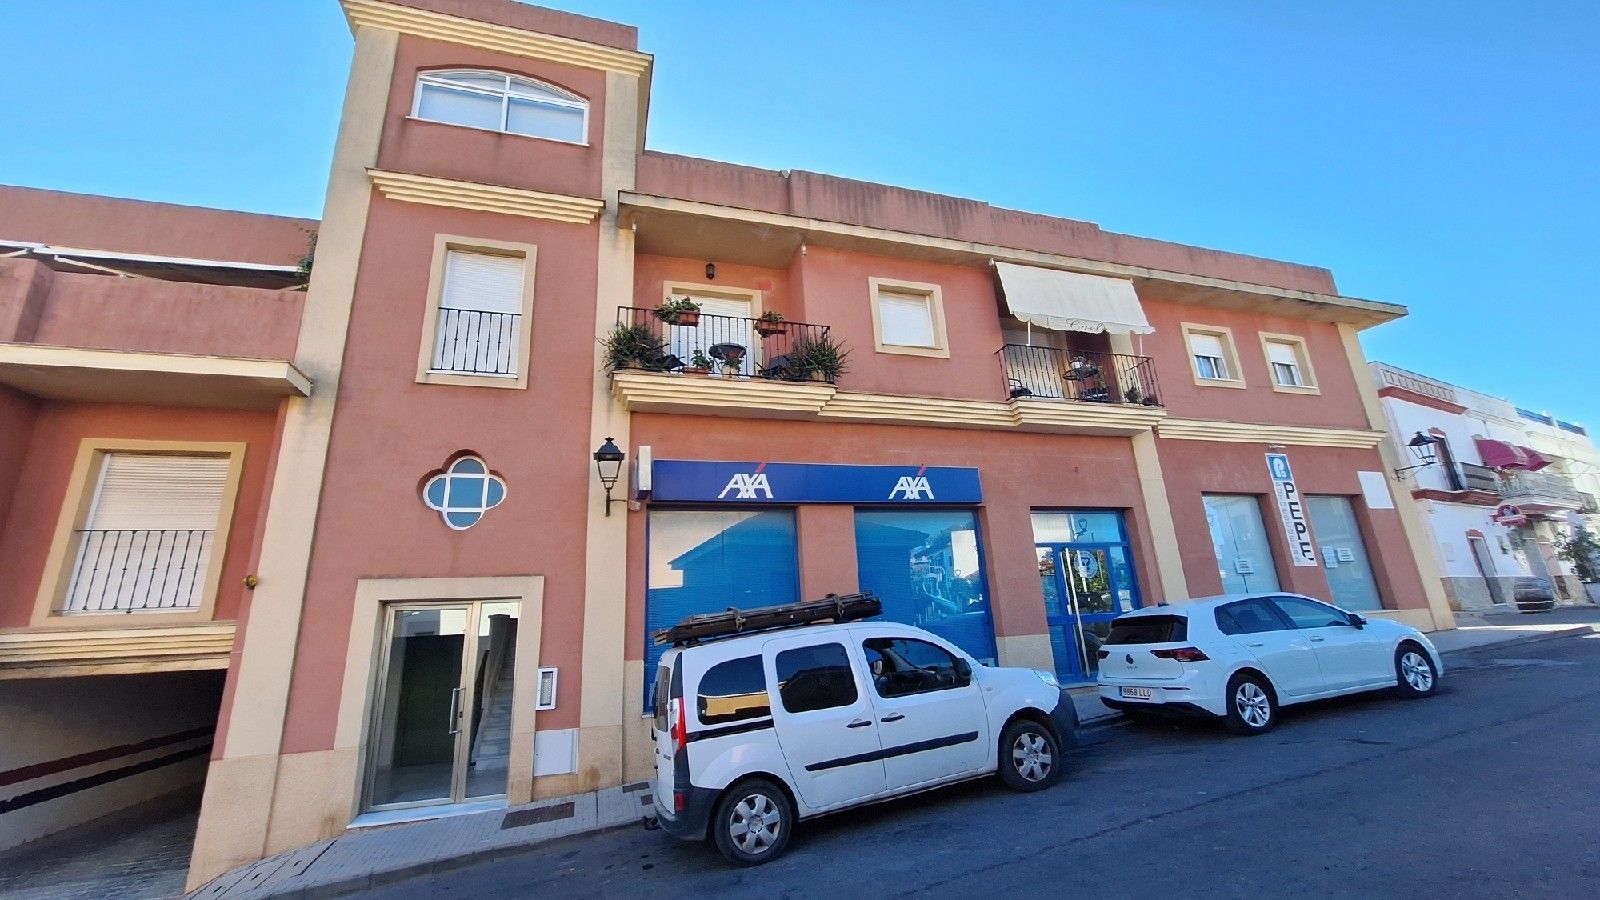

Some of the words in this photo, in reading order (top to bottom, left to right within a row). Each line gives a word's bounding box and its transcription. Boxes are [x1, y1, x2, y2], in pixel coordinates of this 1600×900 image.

[718, 472, 774, 499] AXA
[888, 475, 935, 500] AXA
[1282, 481, 1315, 561] PEPE
